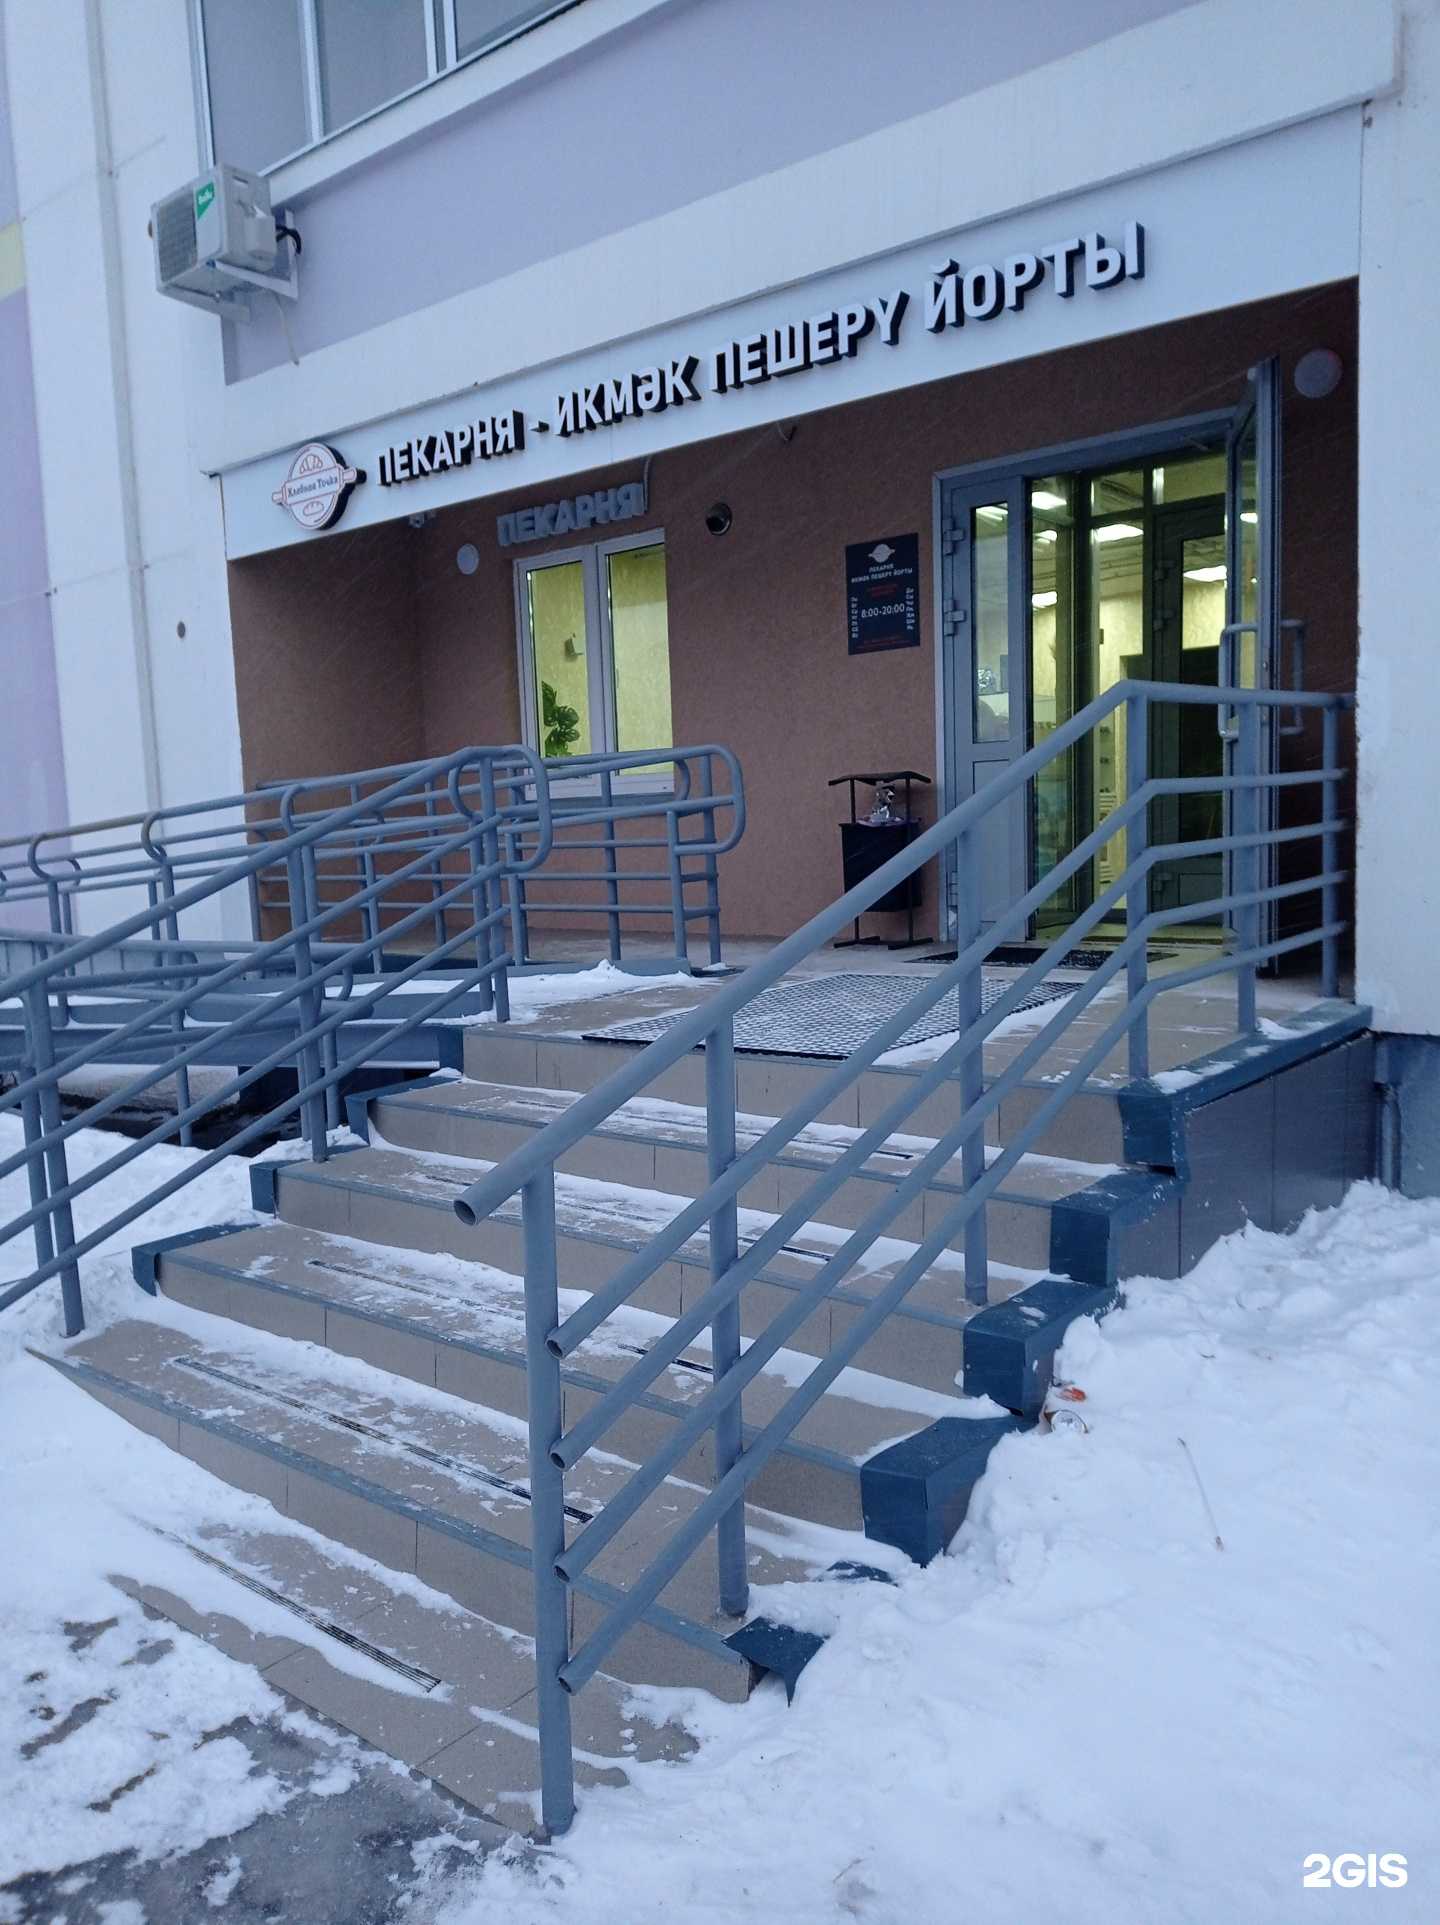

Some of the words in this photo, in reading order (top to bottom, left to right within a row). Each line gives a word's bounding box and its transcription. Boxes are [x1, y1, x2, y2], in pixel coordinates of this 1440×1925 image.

[377, 410, 525, 487] ПЕКАРНЯ
[923, 220, 1145, 333] ЙОРТЫ
[497, 483, 645, 546] ПЕКАРНЯ
